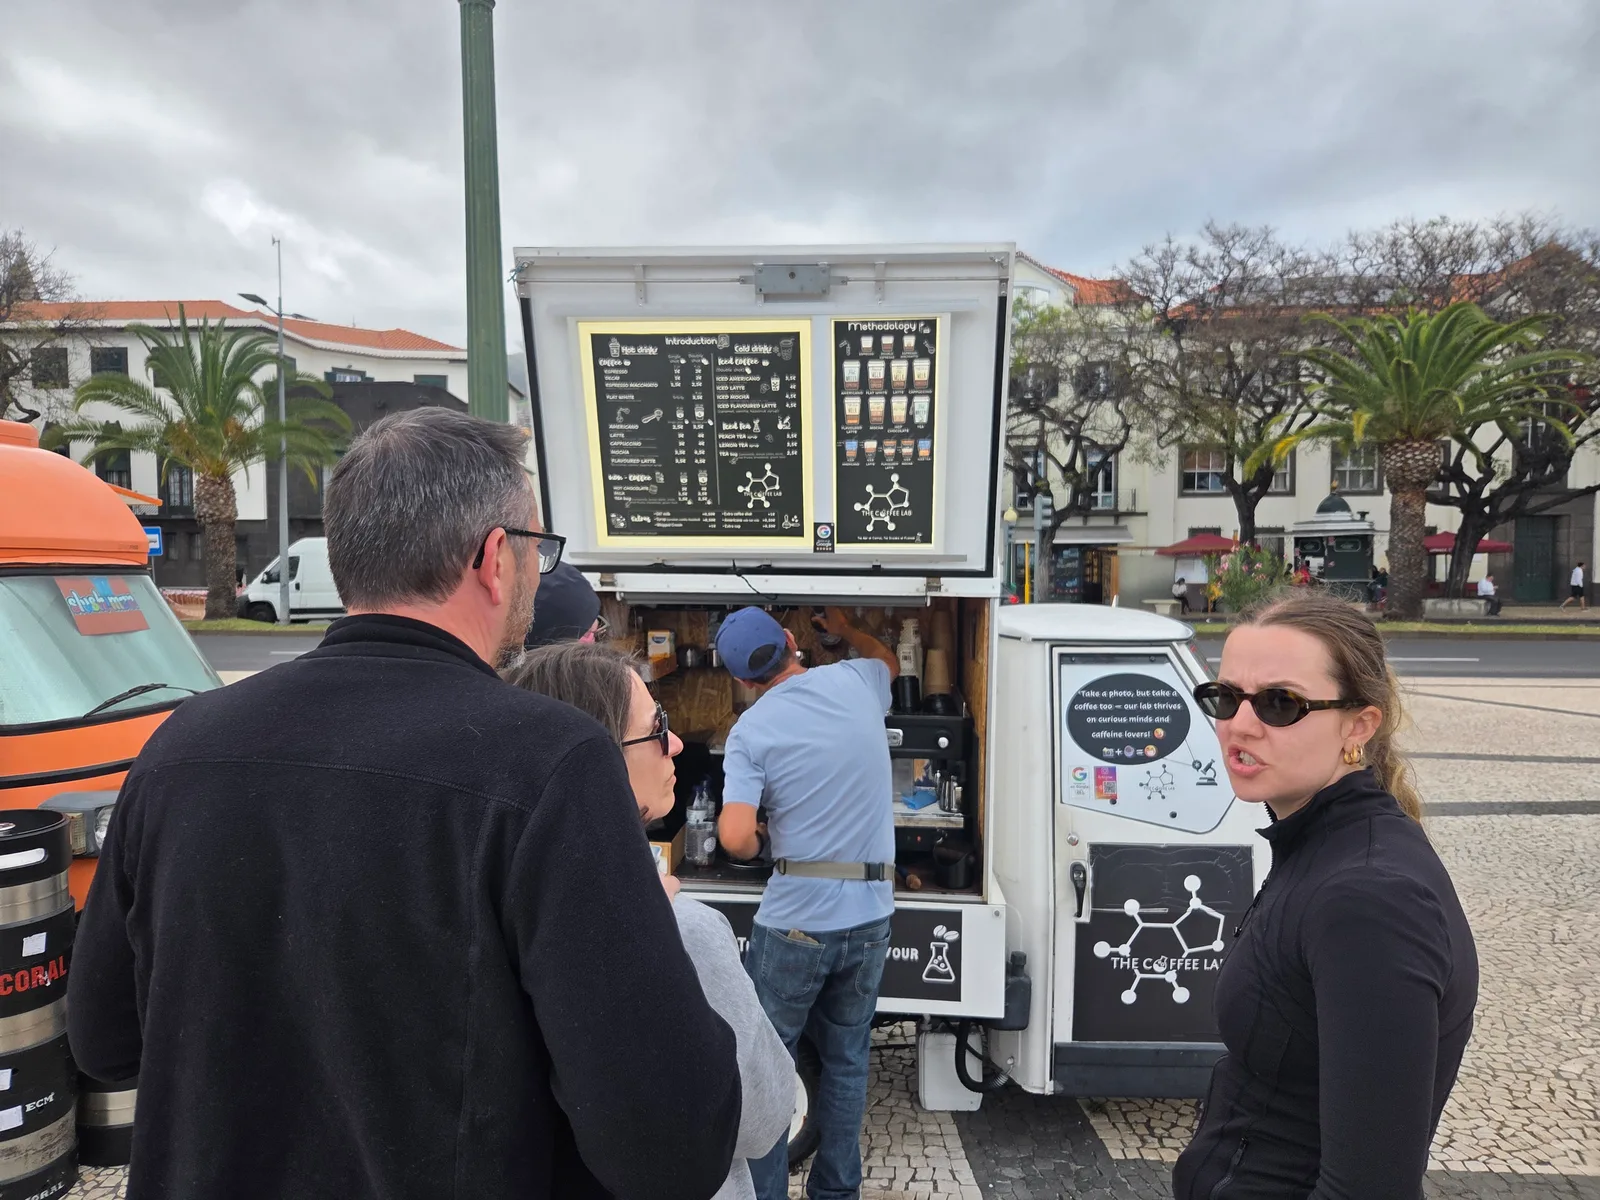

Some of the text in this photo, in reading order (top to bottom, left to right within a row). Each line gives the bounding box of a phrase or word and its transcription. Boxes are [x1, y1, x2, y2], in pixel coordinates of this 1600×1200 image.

[848, 322, 917, 334] Methodology
[665, 336, 717, 345] Introduction
[621, 346, 636, 355] Hot
[734, 344, 772, 354] Cold drinks
[875, 508, 899, 517] COFFEE
[1109, 690, 1134, 698] photo,
[1129, 715, 1152, 723] minds
[1154, 715, 1170, 723] and
[1091, 730, 1150, 738] caffeine lovers!
[1111, 955, 1223, 973] THE COFFEE LA
[0, 955, 67, 996] CORAL
[25, 1091, 55, 1112] ECM
[25, 1181, 65, 1200] ORAL
